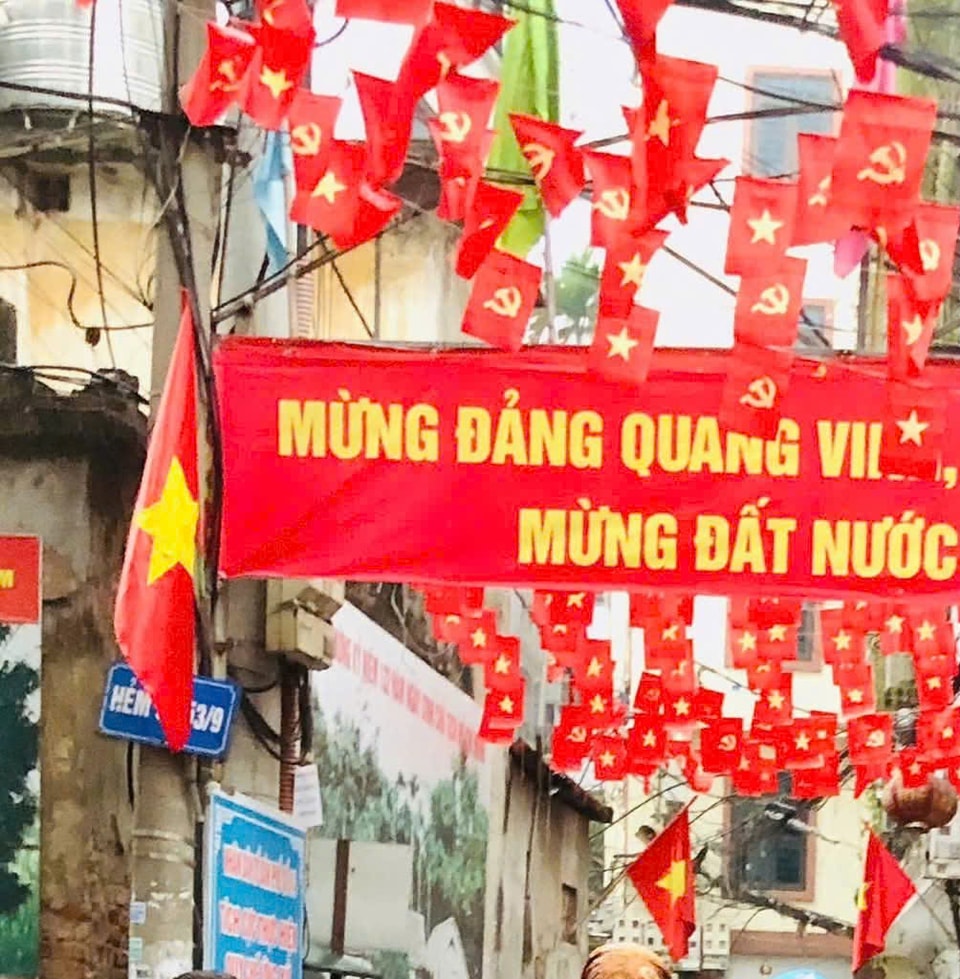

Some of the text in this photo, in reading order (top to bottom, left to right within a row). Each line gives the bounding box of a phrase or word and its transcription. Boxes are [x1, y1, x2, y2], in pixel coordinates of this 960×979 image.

[278, 388, 440, 463] MỪNG
[455, 388, 603, 469] ĐẢNG
[620, 410, 800, 477] QUANG
[816, 420, 958, 489] VI,
[518, 498, 679, 570] MỪNG
[694, 497, 797, 574] ĐẤT
[811, 510, 959, 580] NƯỚC
